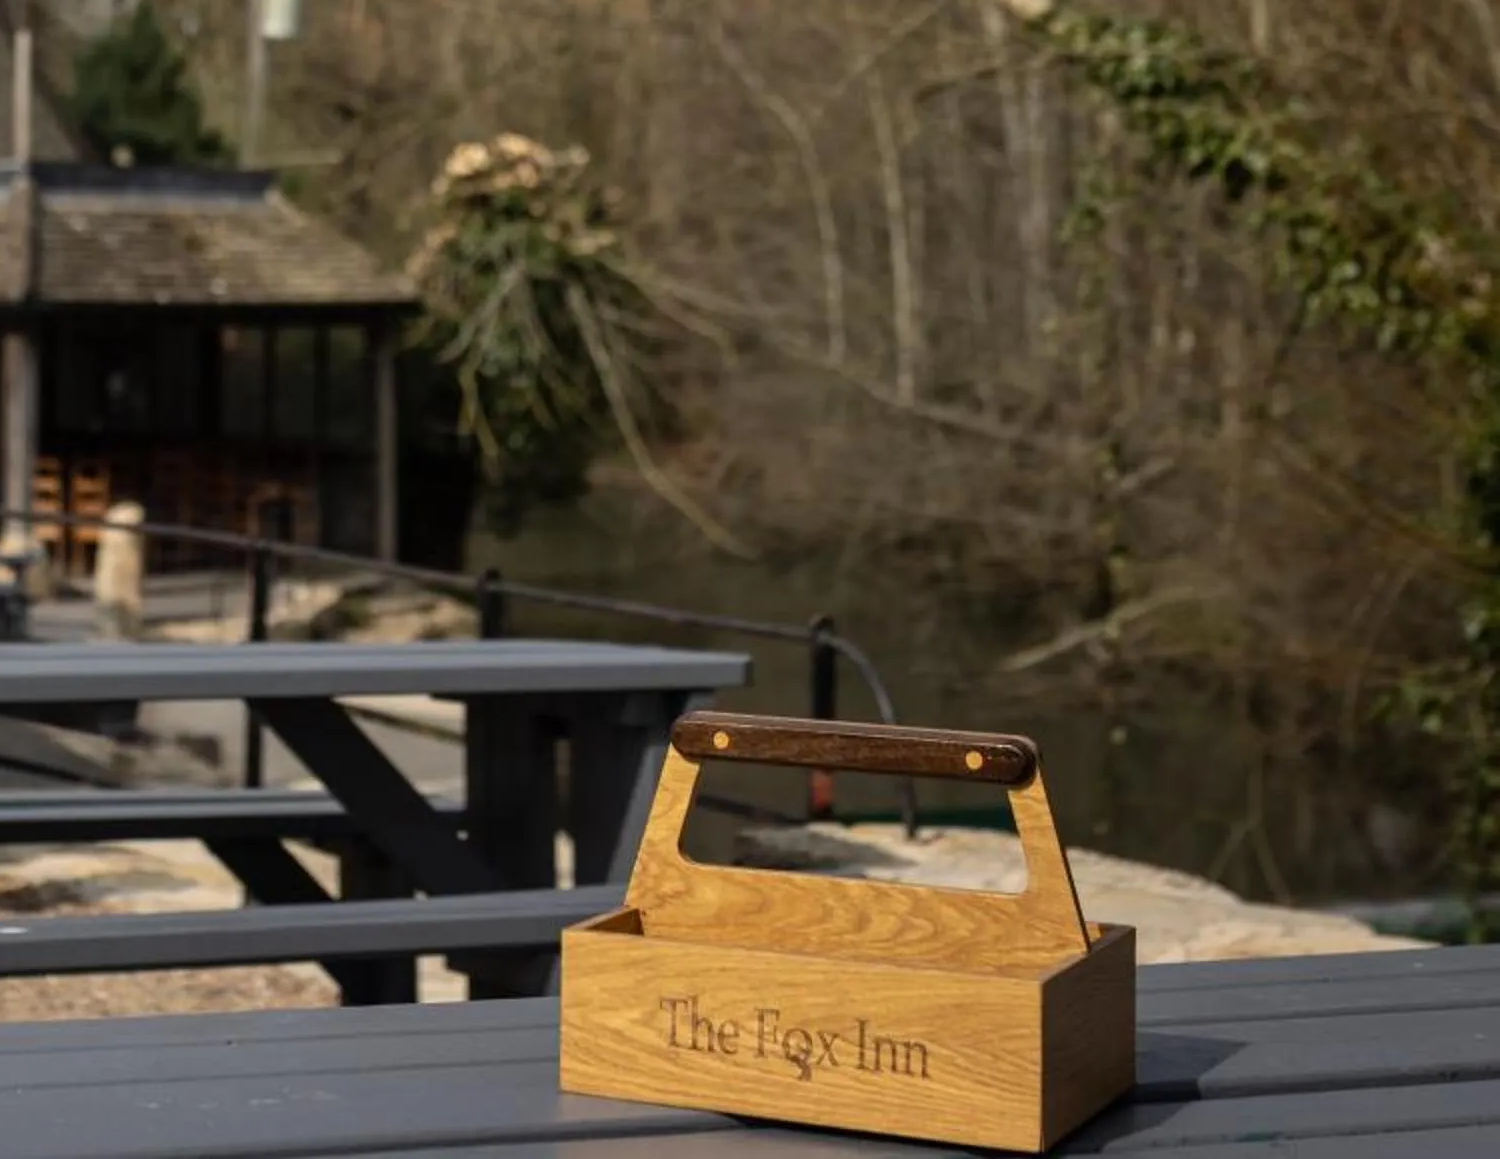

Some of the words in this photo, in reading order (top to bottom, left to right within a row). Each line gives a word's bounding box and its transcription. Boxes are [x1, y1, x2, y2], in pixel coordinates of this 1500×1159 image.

[659, 994, 740, 1055] The
[753, 1008, 841, 1080] Fox
[855, 1017, 930, 1080] Inn
